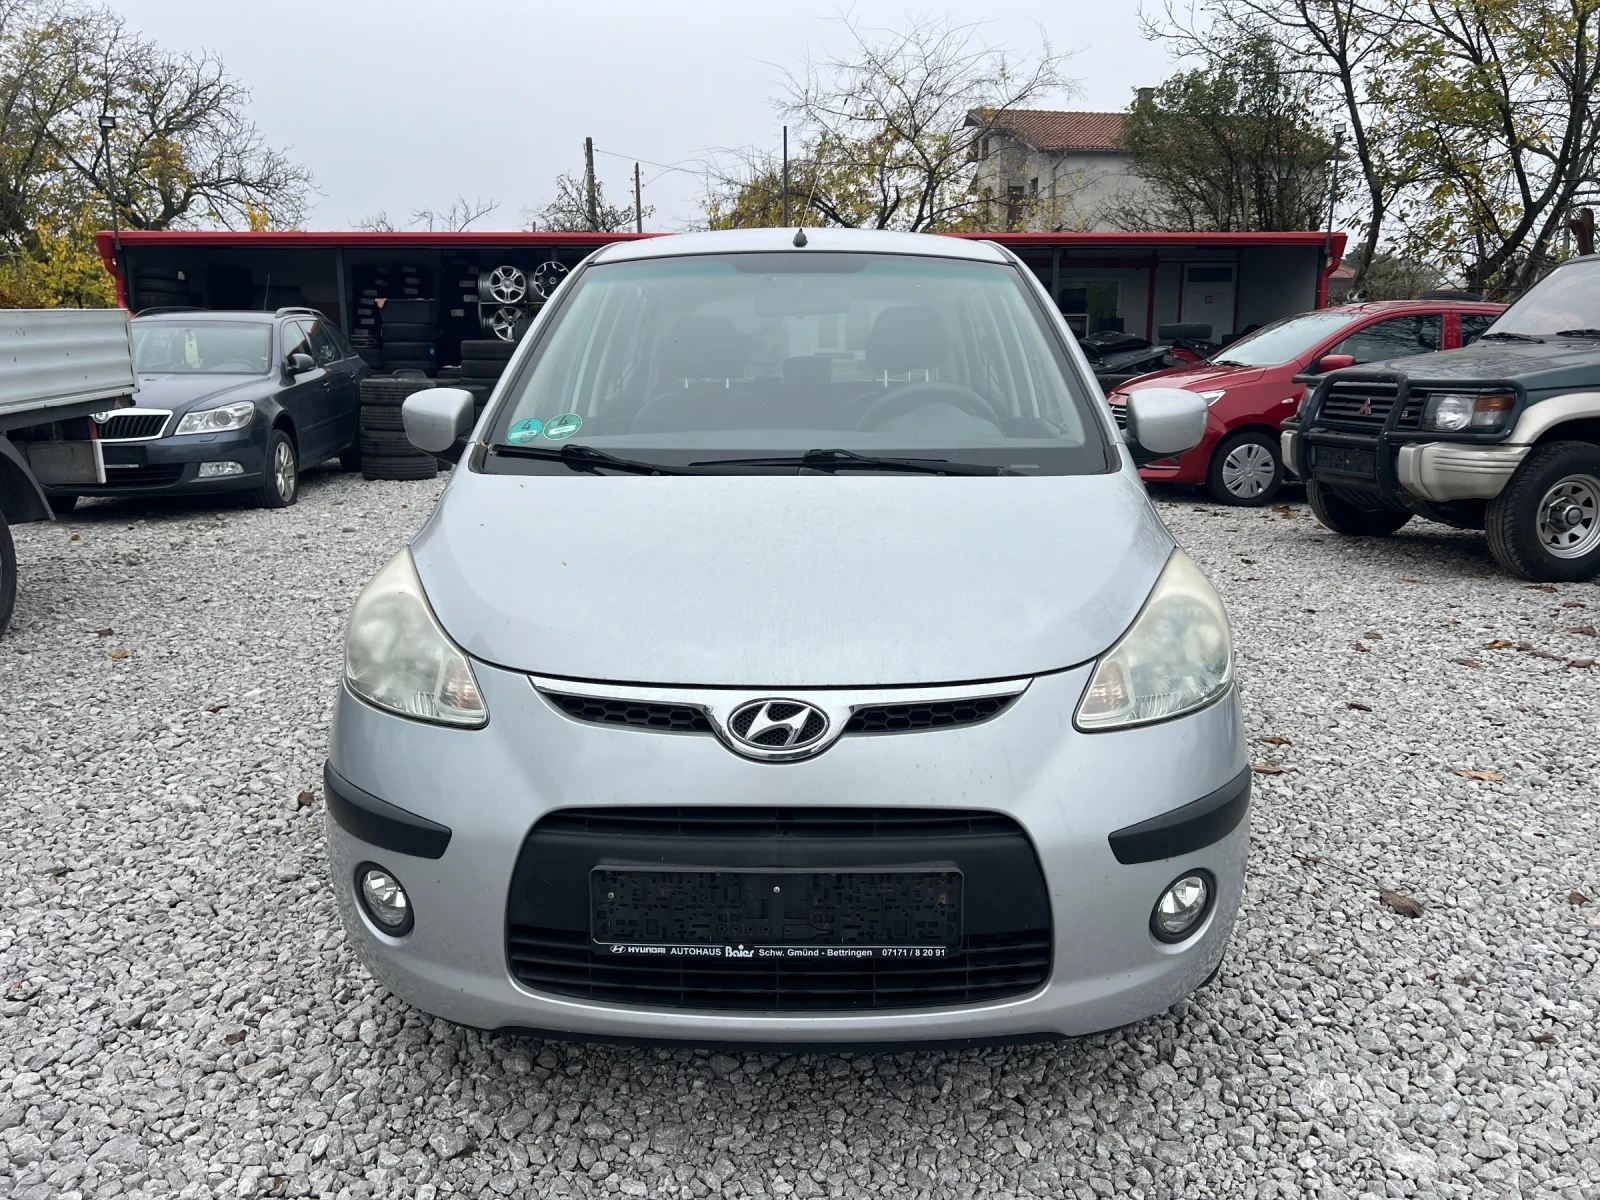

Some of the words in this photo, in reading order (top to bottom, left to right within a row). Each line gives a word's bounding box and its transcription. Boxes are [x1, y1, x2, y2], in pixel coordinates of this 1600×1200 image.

[521, 419, 532, 430] 4
[557, 415, 569, 426] 4
[628, 946, 666, 954] HYUNDAI
[670, 947, 722, 956] AUTOHAUS
[725, 944, 754, 958] Baier
[758, 948, 785, 957] Schw.
[787, 948, 819, 957] Gmünd
[827, 948, 873, 958] Bettringen
[882, 948, 908, 957] 07171
[914, 948, 921, 957] 8
[922, 948, 933, 957] 20
[935, 948, 946, 957] 91
